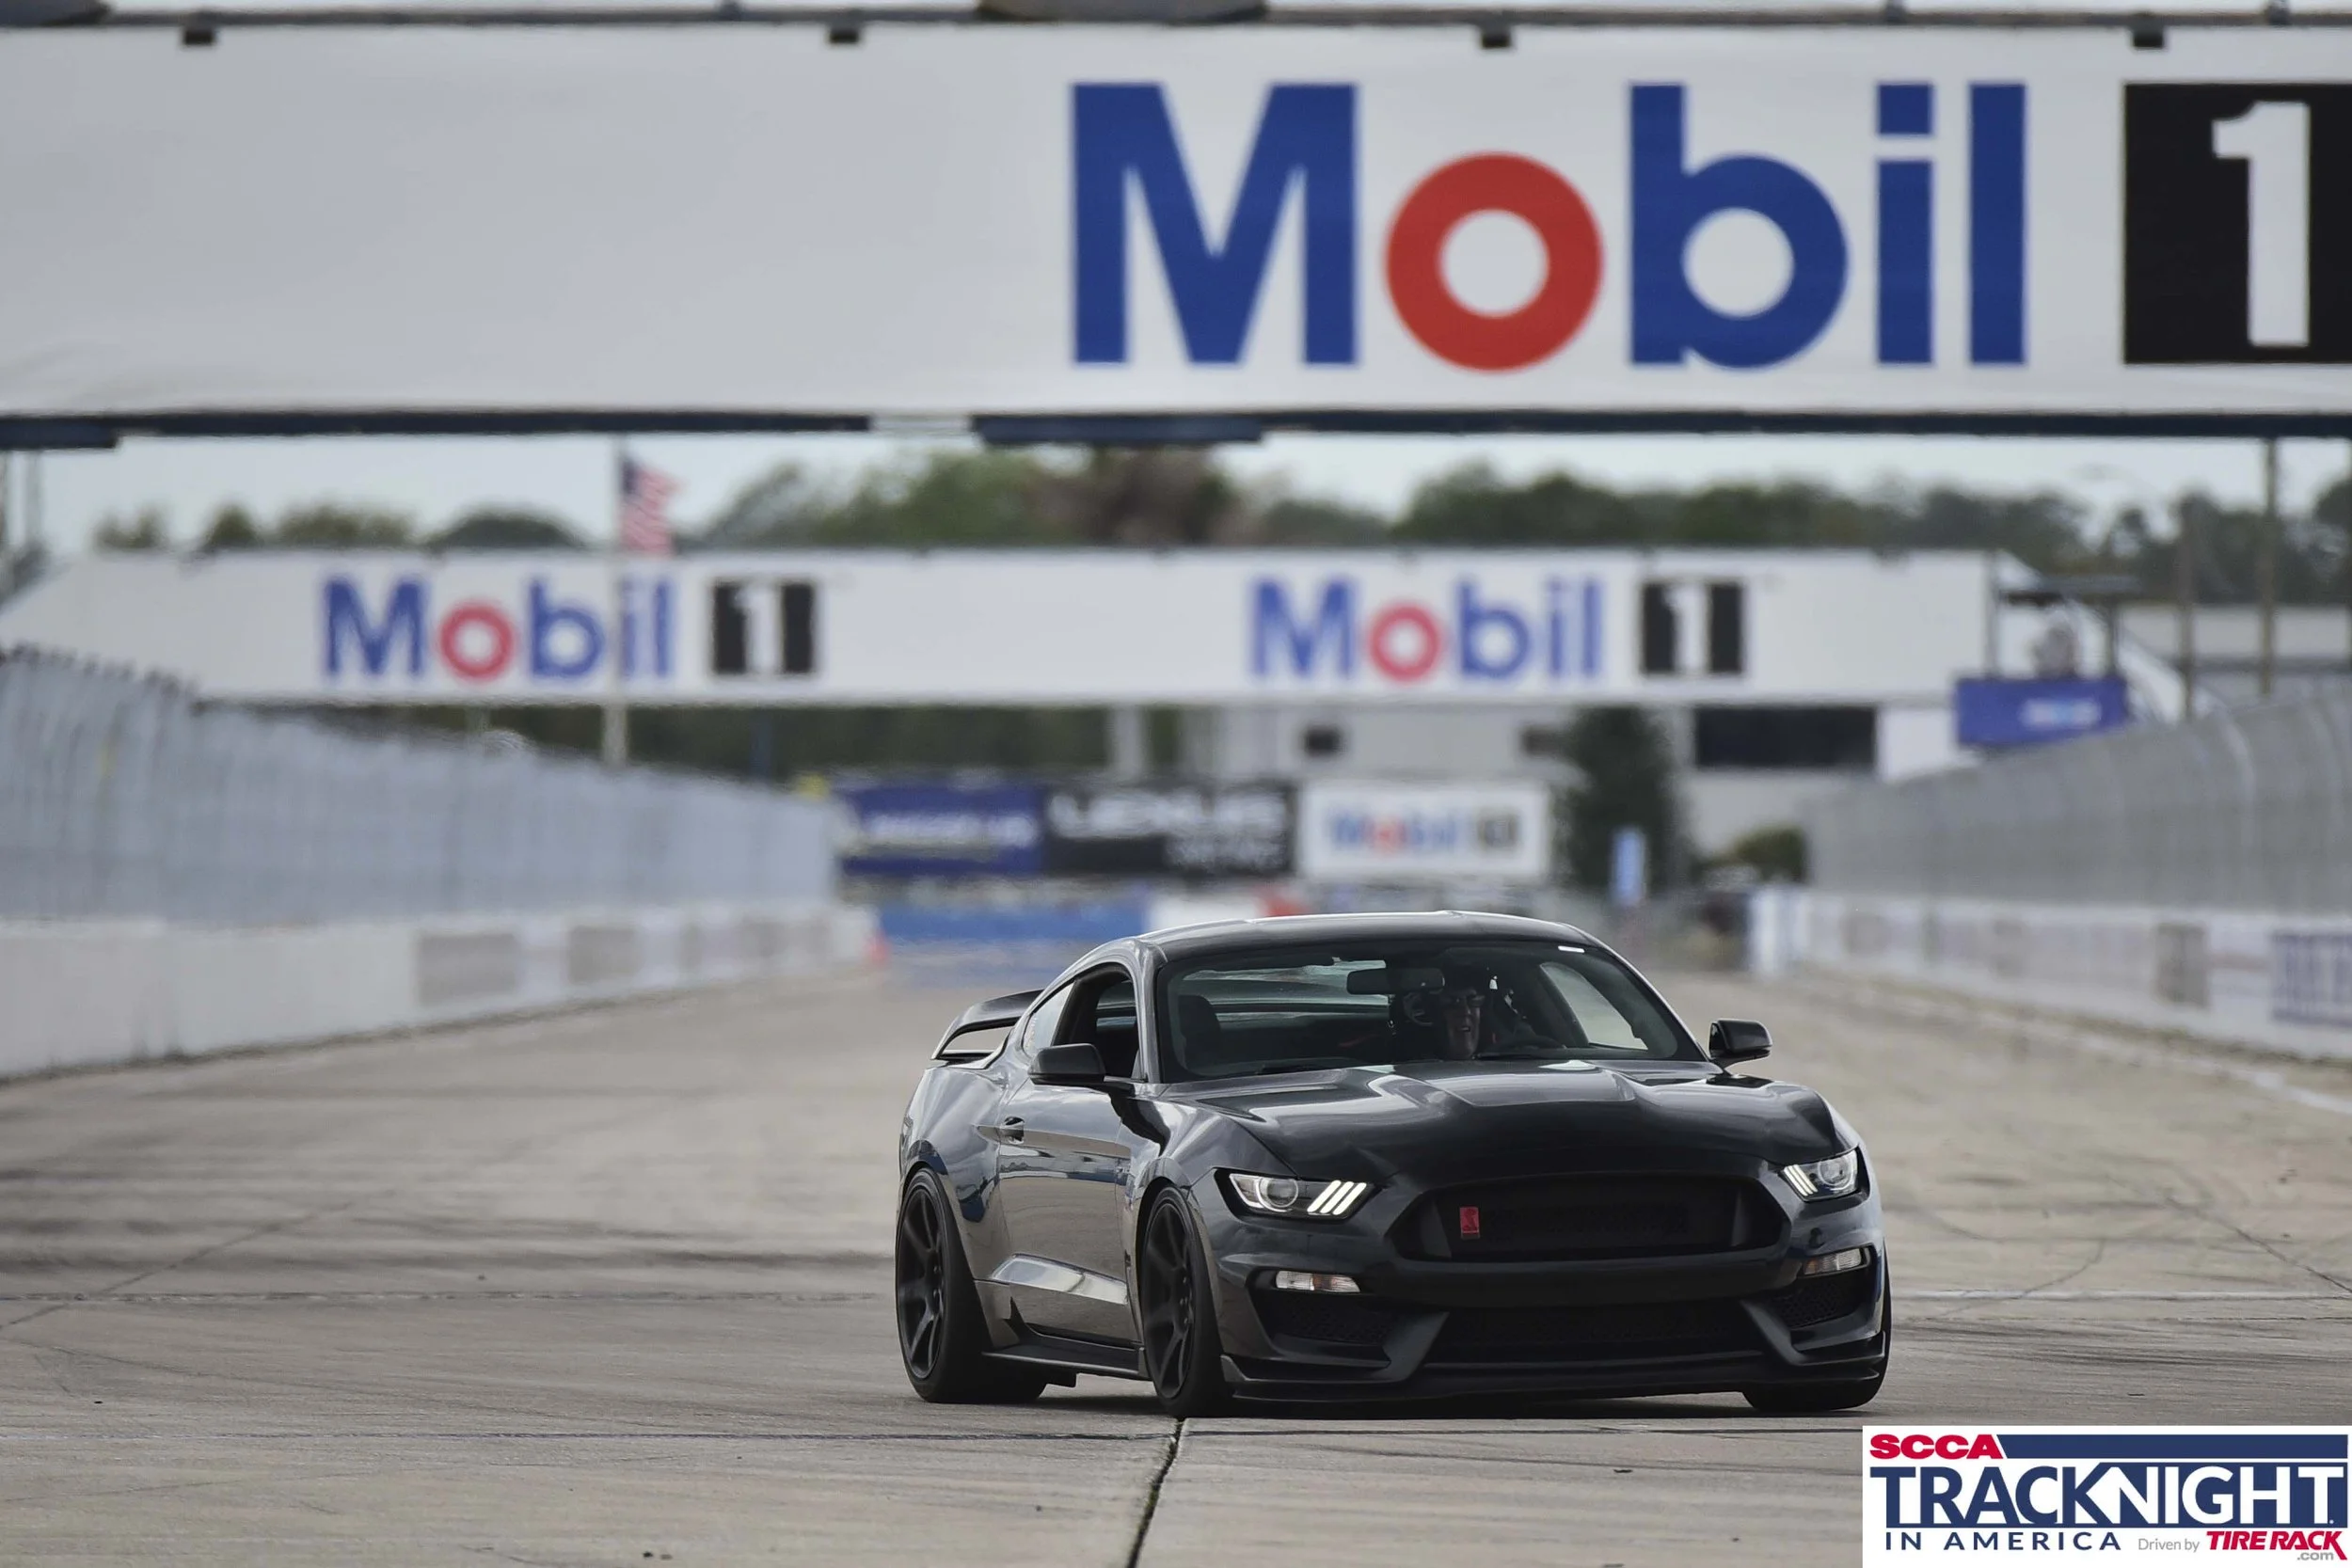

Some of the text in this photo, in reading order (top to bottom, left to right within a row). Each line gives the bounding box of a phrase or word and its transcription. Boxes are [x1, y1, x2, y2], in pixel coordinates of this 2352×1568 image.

[1071, 83, 2310, 371] Mobil 1
[322, 576, 675, 684] Mobil
[1249, 576, 1605, 685] Mobil
